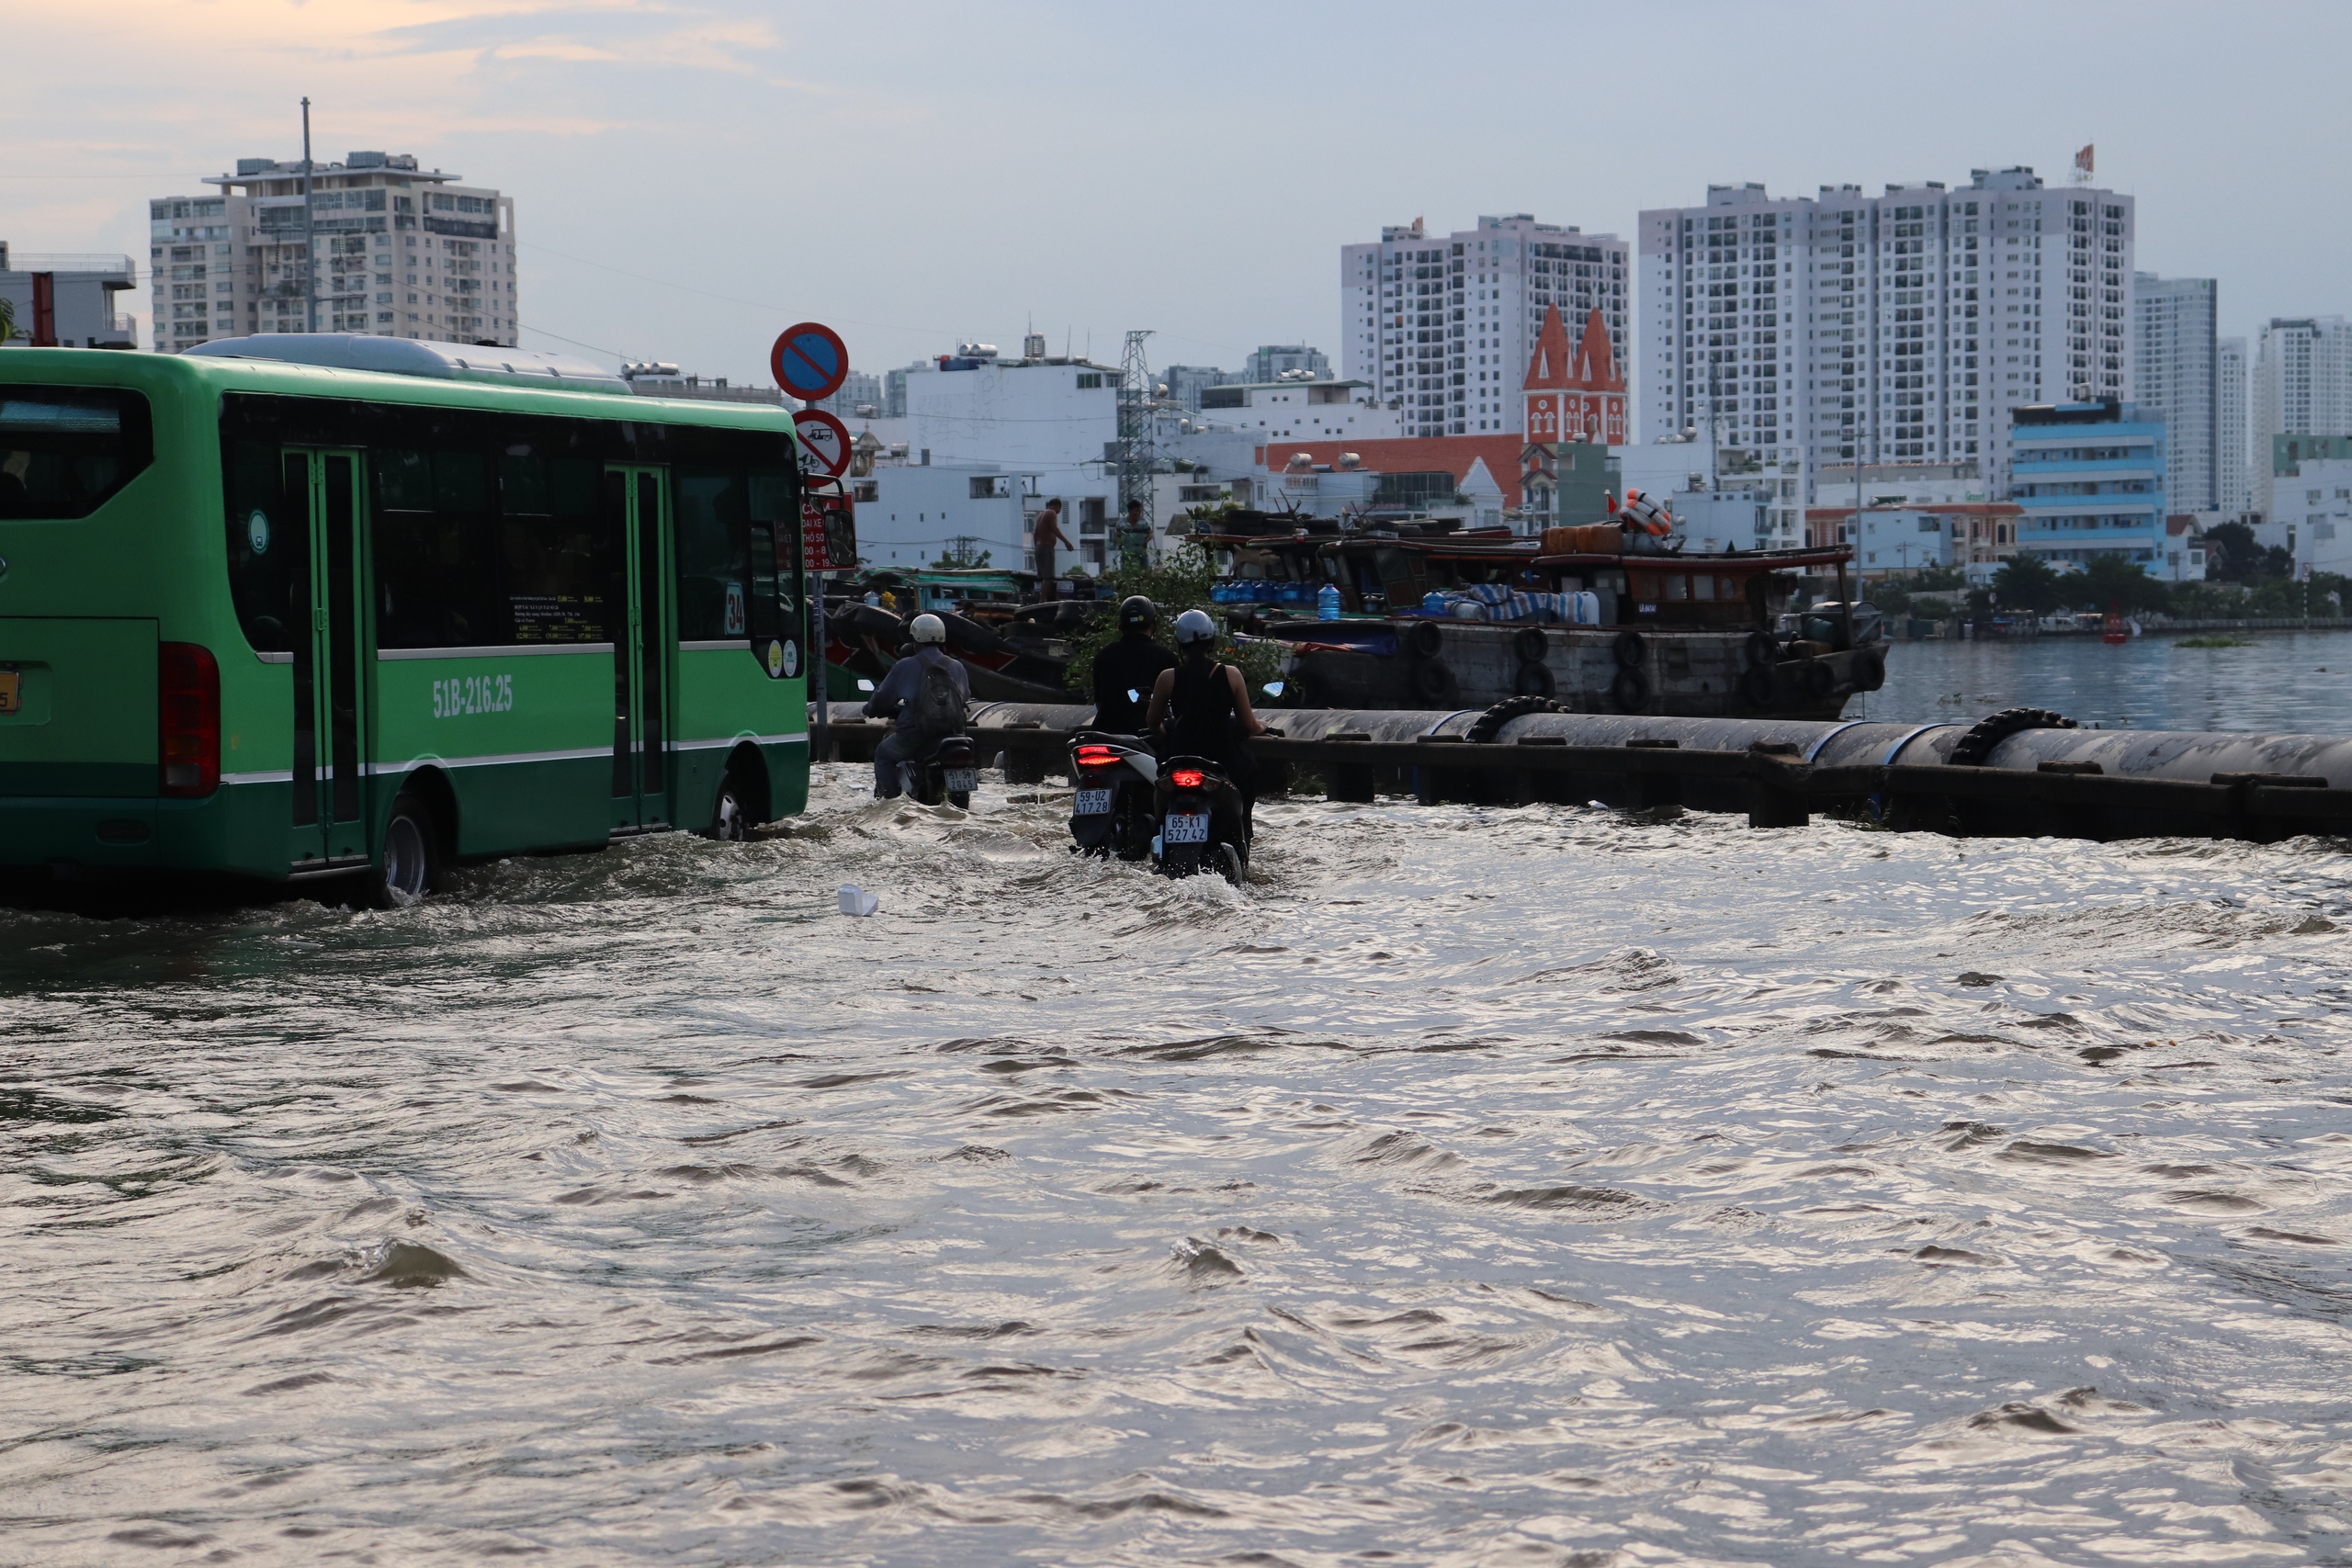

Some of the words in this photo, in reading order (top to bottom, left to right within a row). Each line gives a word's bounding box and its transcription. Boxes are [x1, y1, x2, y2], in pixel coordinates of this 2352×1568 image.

[802, 502, 831, 514] CM
[813, 518, 822, 527] XE
[729, 593, 743, 630] 34
[434, 674, 513, 718] 51B-216.25
[1080, 791, 1106, 803] 59-U2
[1075, 801, 1108, 814] 417.28
[1171, 816, 1200, 829] 65-K1
[1168, 829, 1204, 841] 527.42
